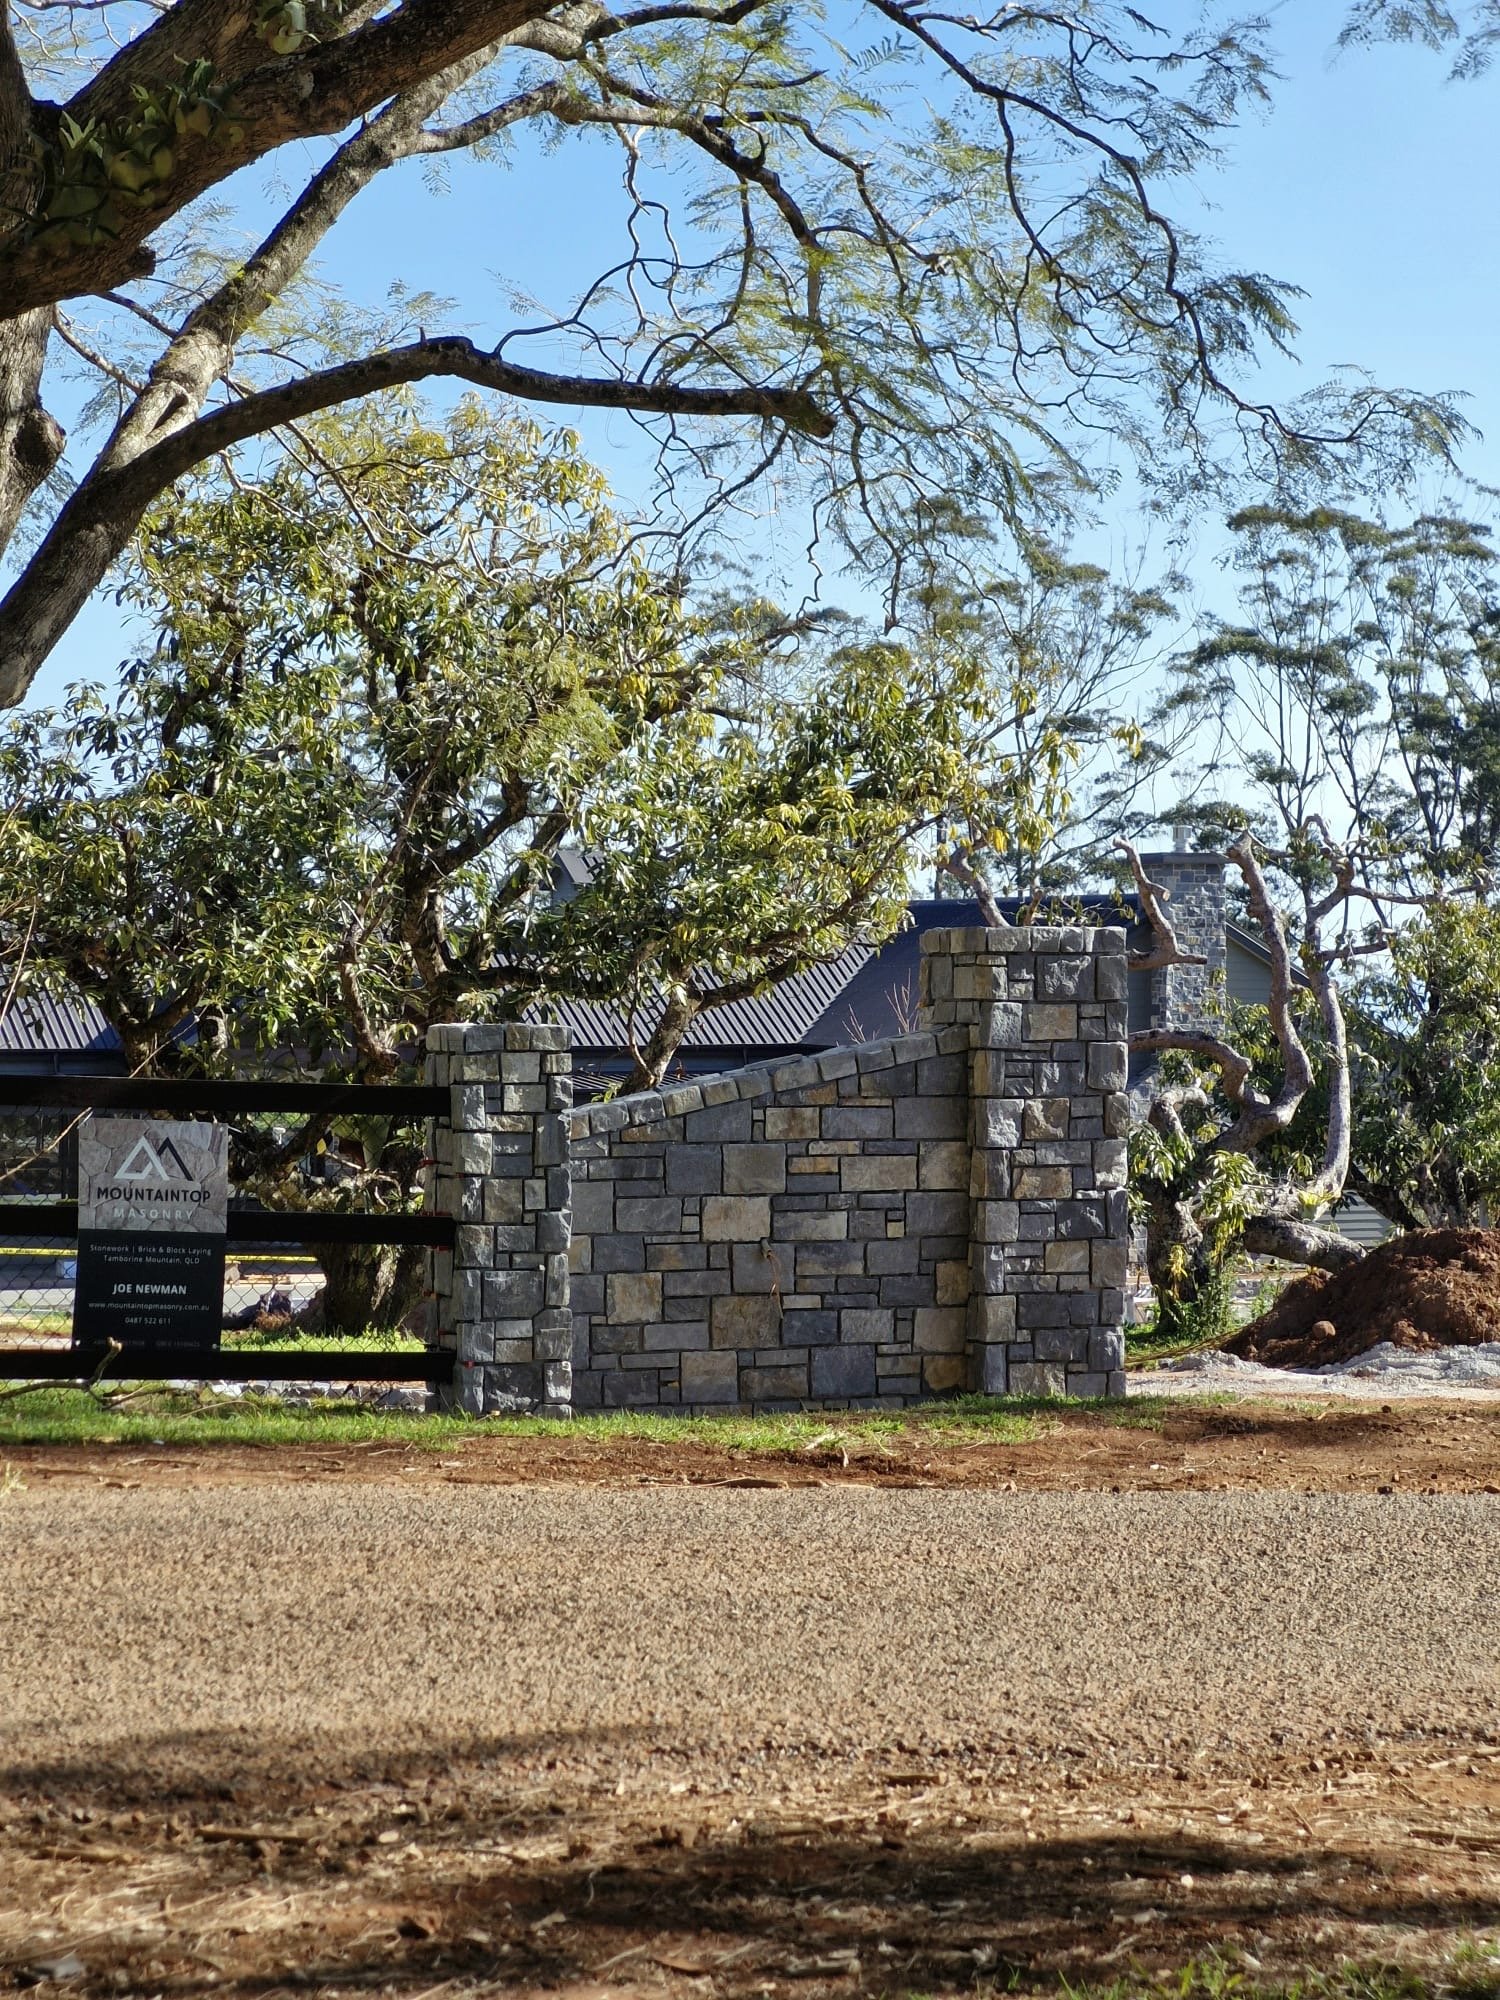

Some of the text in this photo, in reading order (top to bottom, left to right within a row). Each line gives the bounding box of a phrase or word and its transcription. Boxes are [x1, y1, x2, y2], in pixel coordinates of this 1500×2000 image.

[97, 1187, 211, 1203] MOUNTAINTOP
[113, 1208, 194, 1219] MASONRY
[90, 1244, 129, 1252] Stonework
[138, 1245, 156, 1253] Brick
[166, 1246, 186, 1254] Block
[188, 1247, 212, 1256] Laying
[103, 1254, 200, 1265] Tamborine Mountain, QLD
[112, 1283, 187, 1295] JOE NEWMAN
[88, 1302, 210, 1311] www.mountaintopmasonry.com.au
[143, 1317, 157, 1325] 522
[158, 1317, 171, 1325] 611
